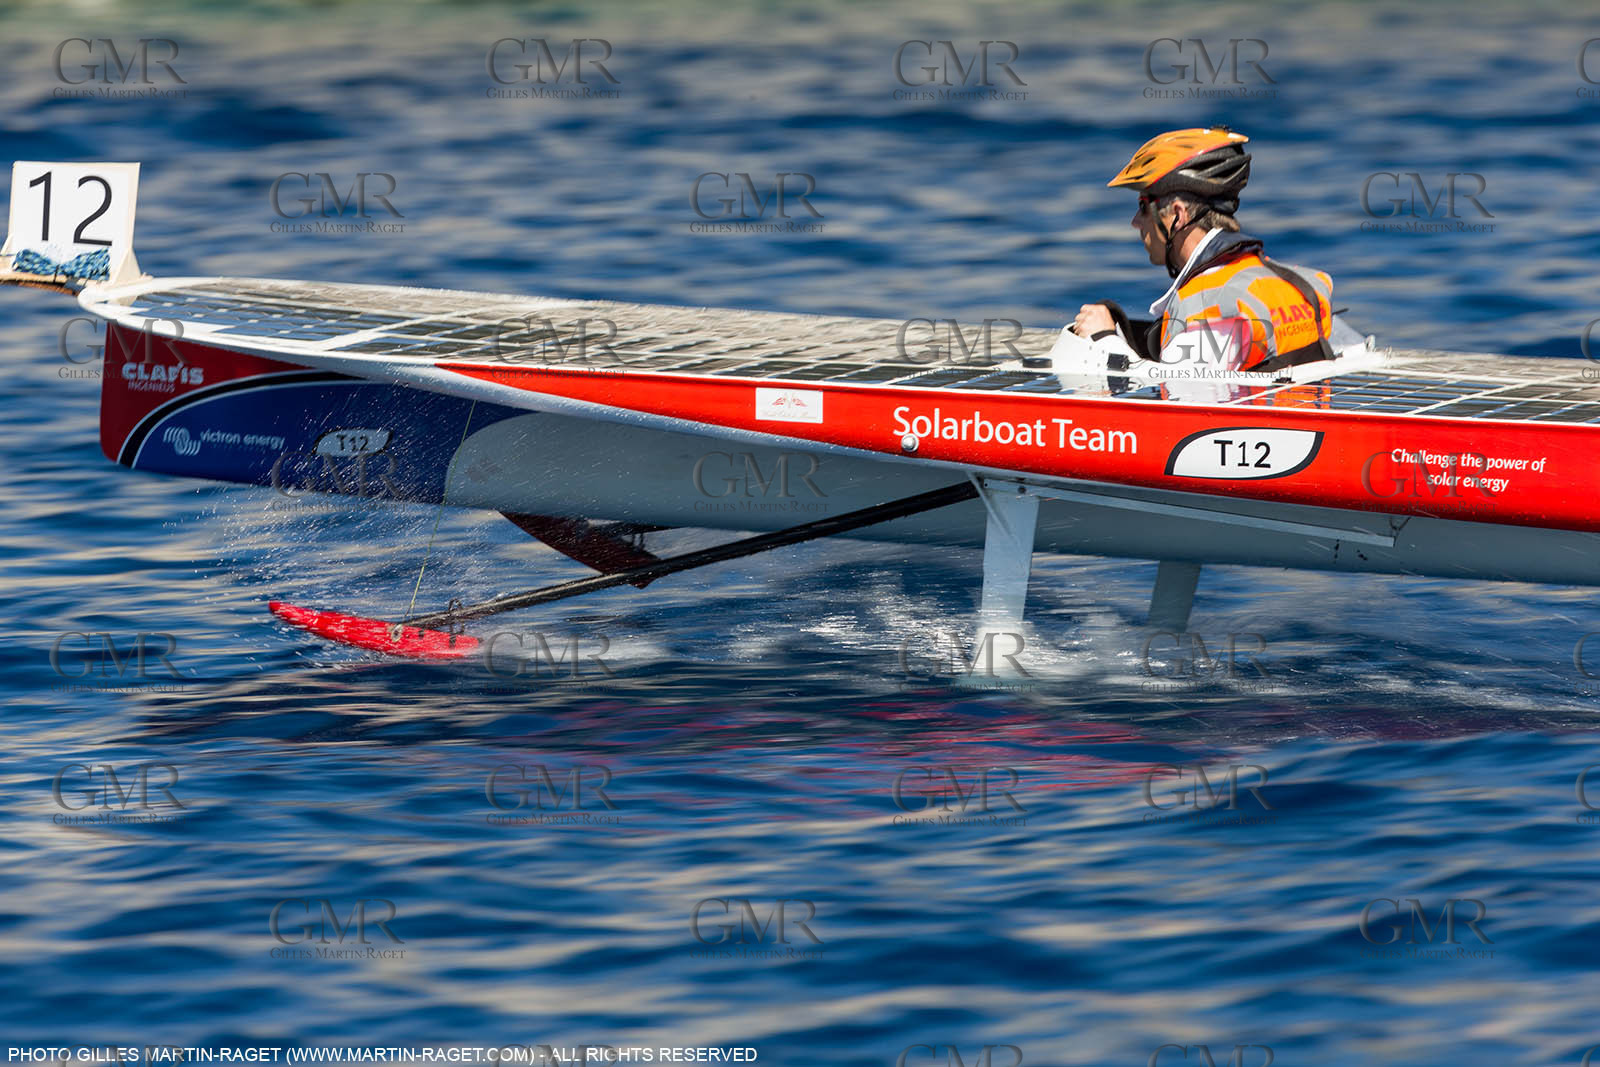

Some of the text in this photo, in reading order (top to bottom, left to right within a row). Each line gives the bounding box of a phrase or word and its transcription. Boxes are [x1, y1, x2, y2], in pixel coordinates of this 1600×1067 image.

[29, 171, 113, 246] 12
[200, 428, 240, 446] victron
[243, 433, 286, 450] energy
[893, 406, 1137, 454] Solarboat Team
[336, 434, 369, 452] T12
[1213, 439, 1271, 468] T12
[1391, 448, 1547, 473] Challenge the power of
[1426, 472, 1509, 492] solar energy
